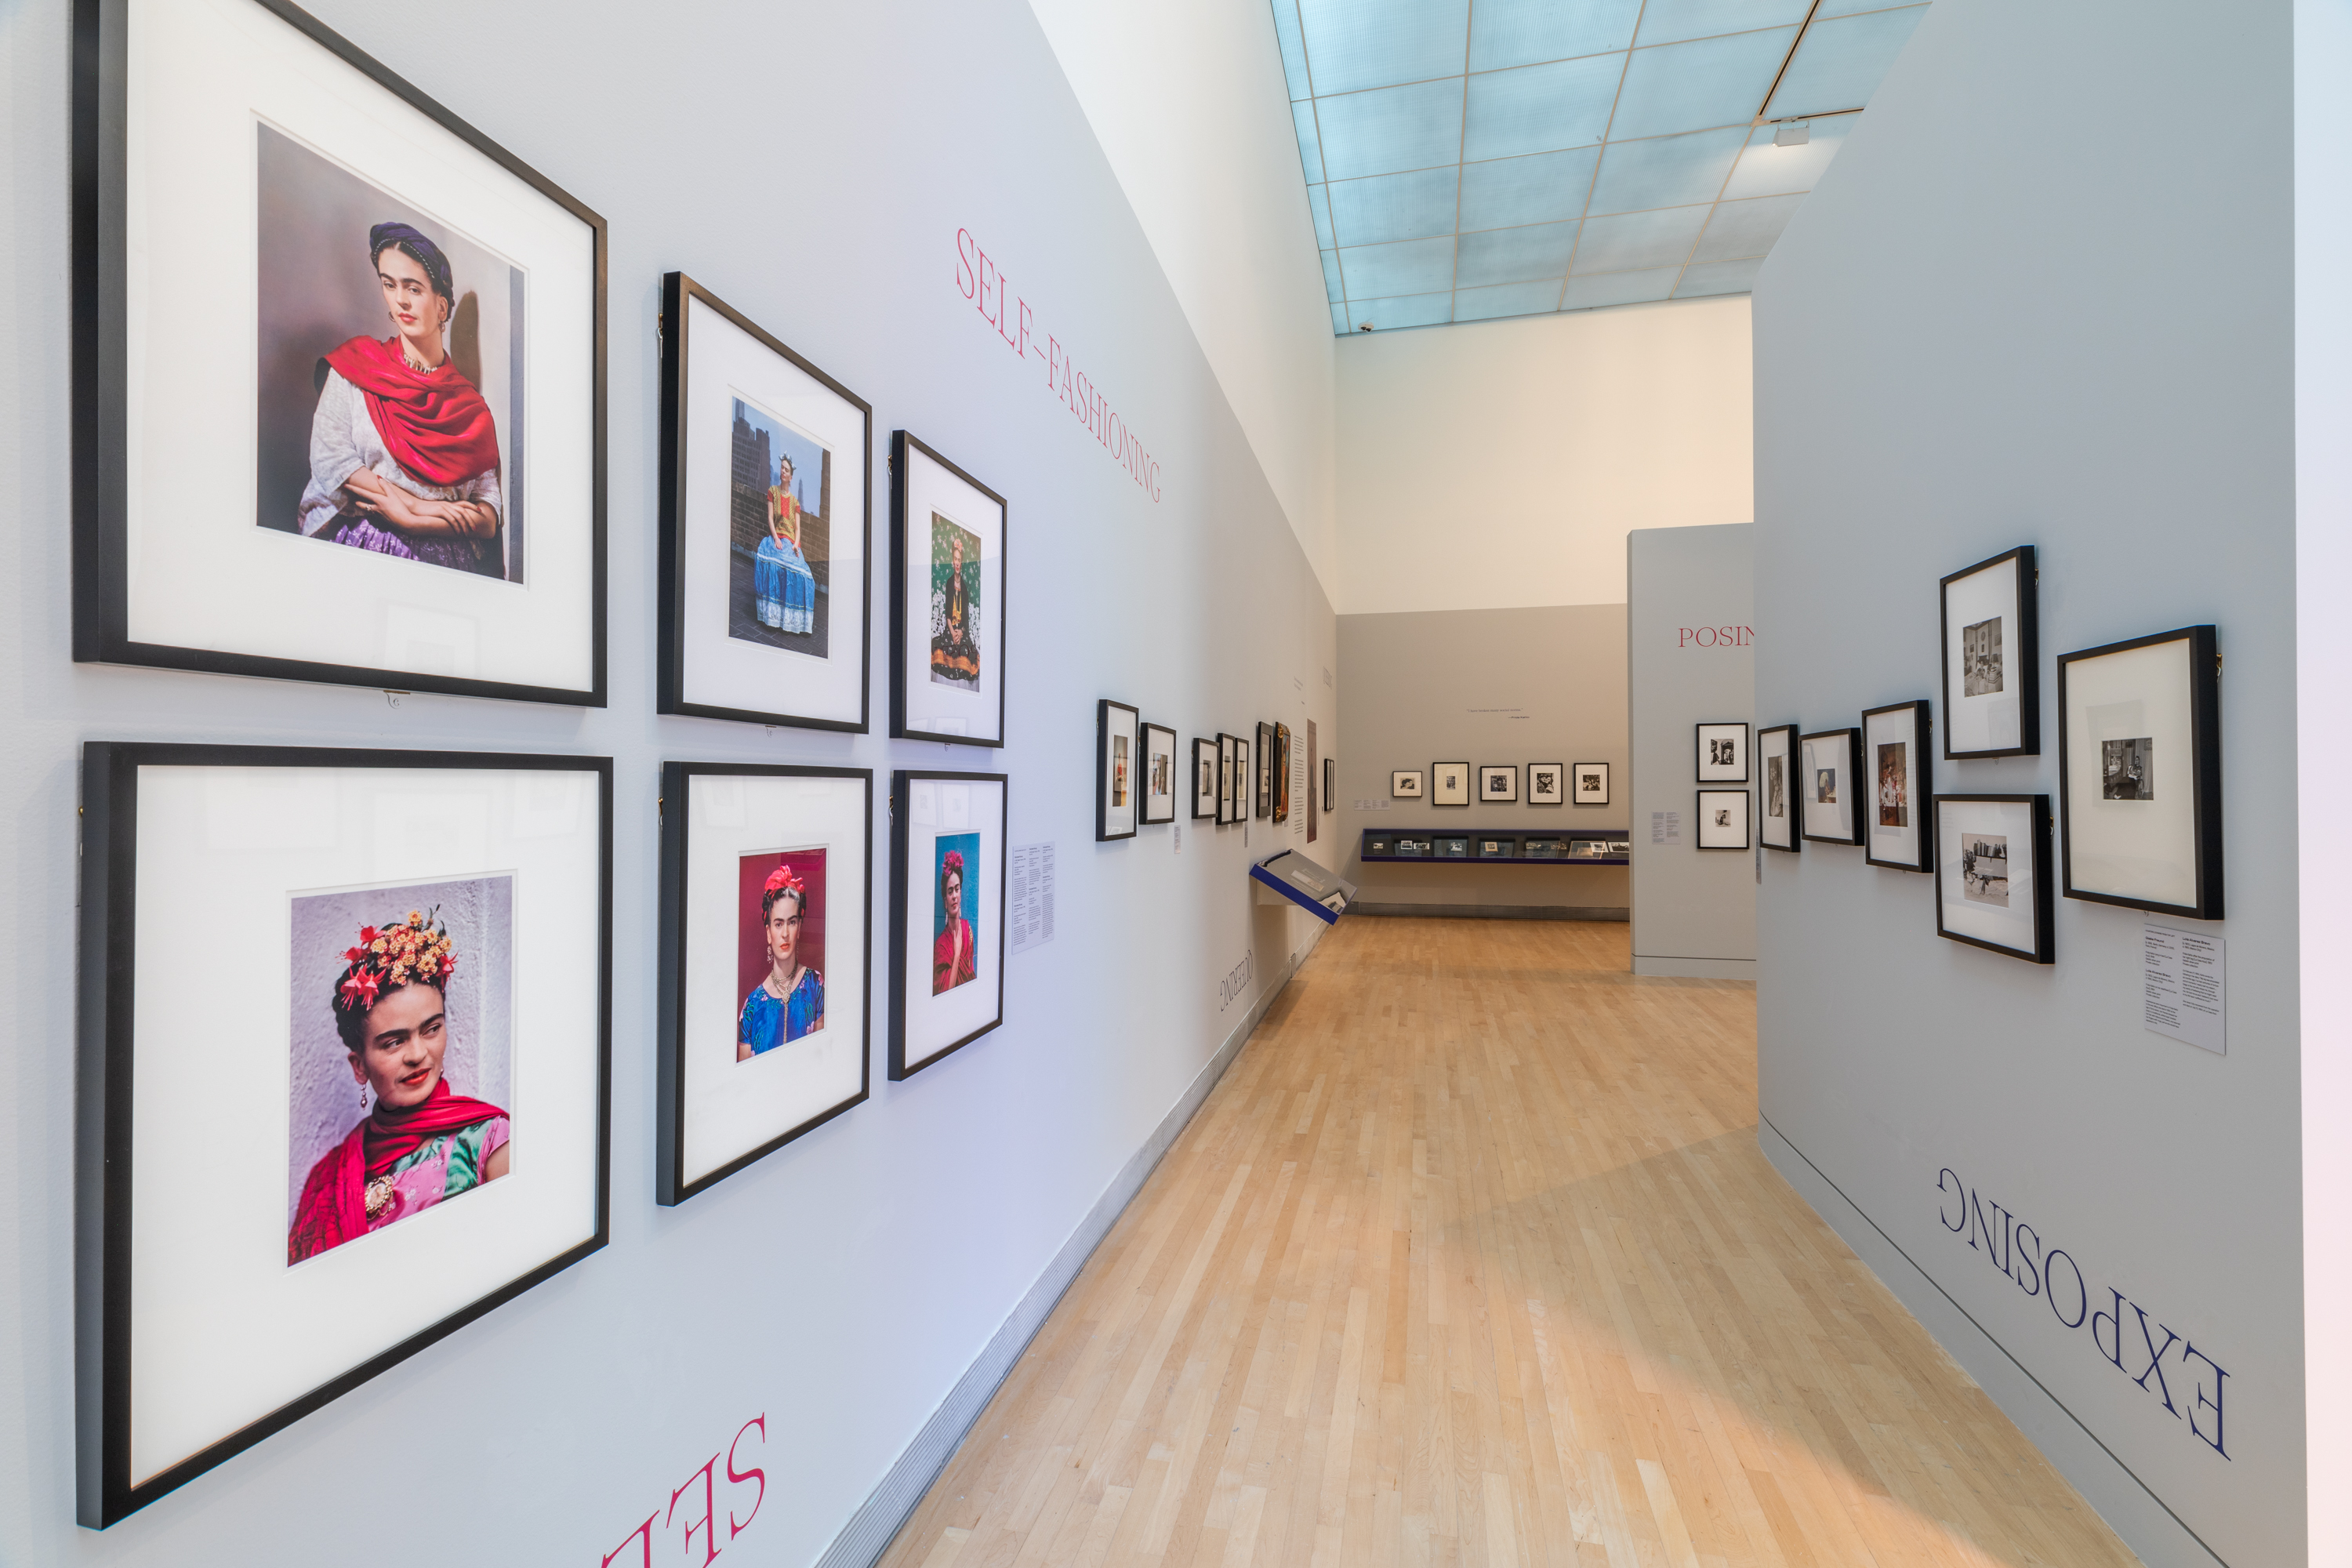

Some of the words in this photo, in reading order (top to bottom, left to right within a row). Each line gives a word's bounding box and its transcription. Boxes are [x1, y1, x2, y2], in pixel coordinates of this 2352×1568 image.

[956, 227, 1160, 503] SELF-FASHIONING
[1220, 949, 1253, 1011] QUEERING
[1936, 1167, 2231, 1461] EXPOSING
